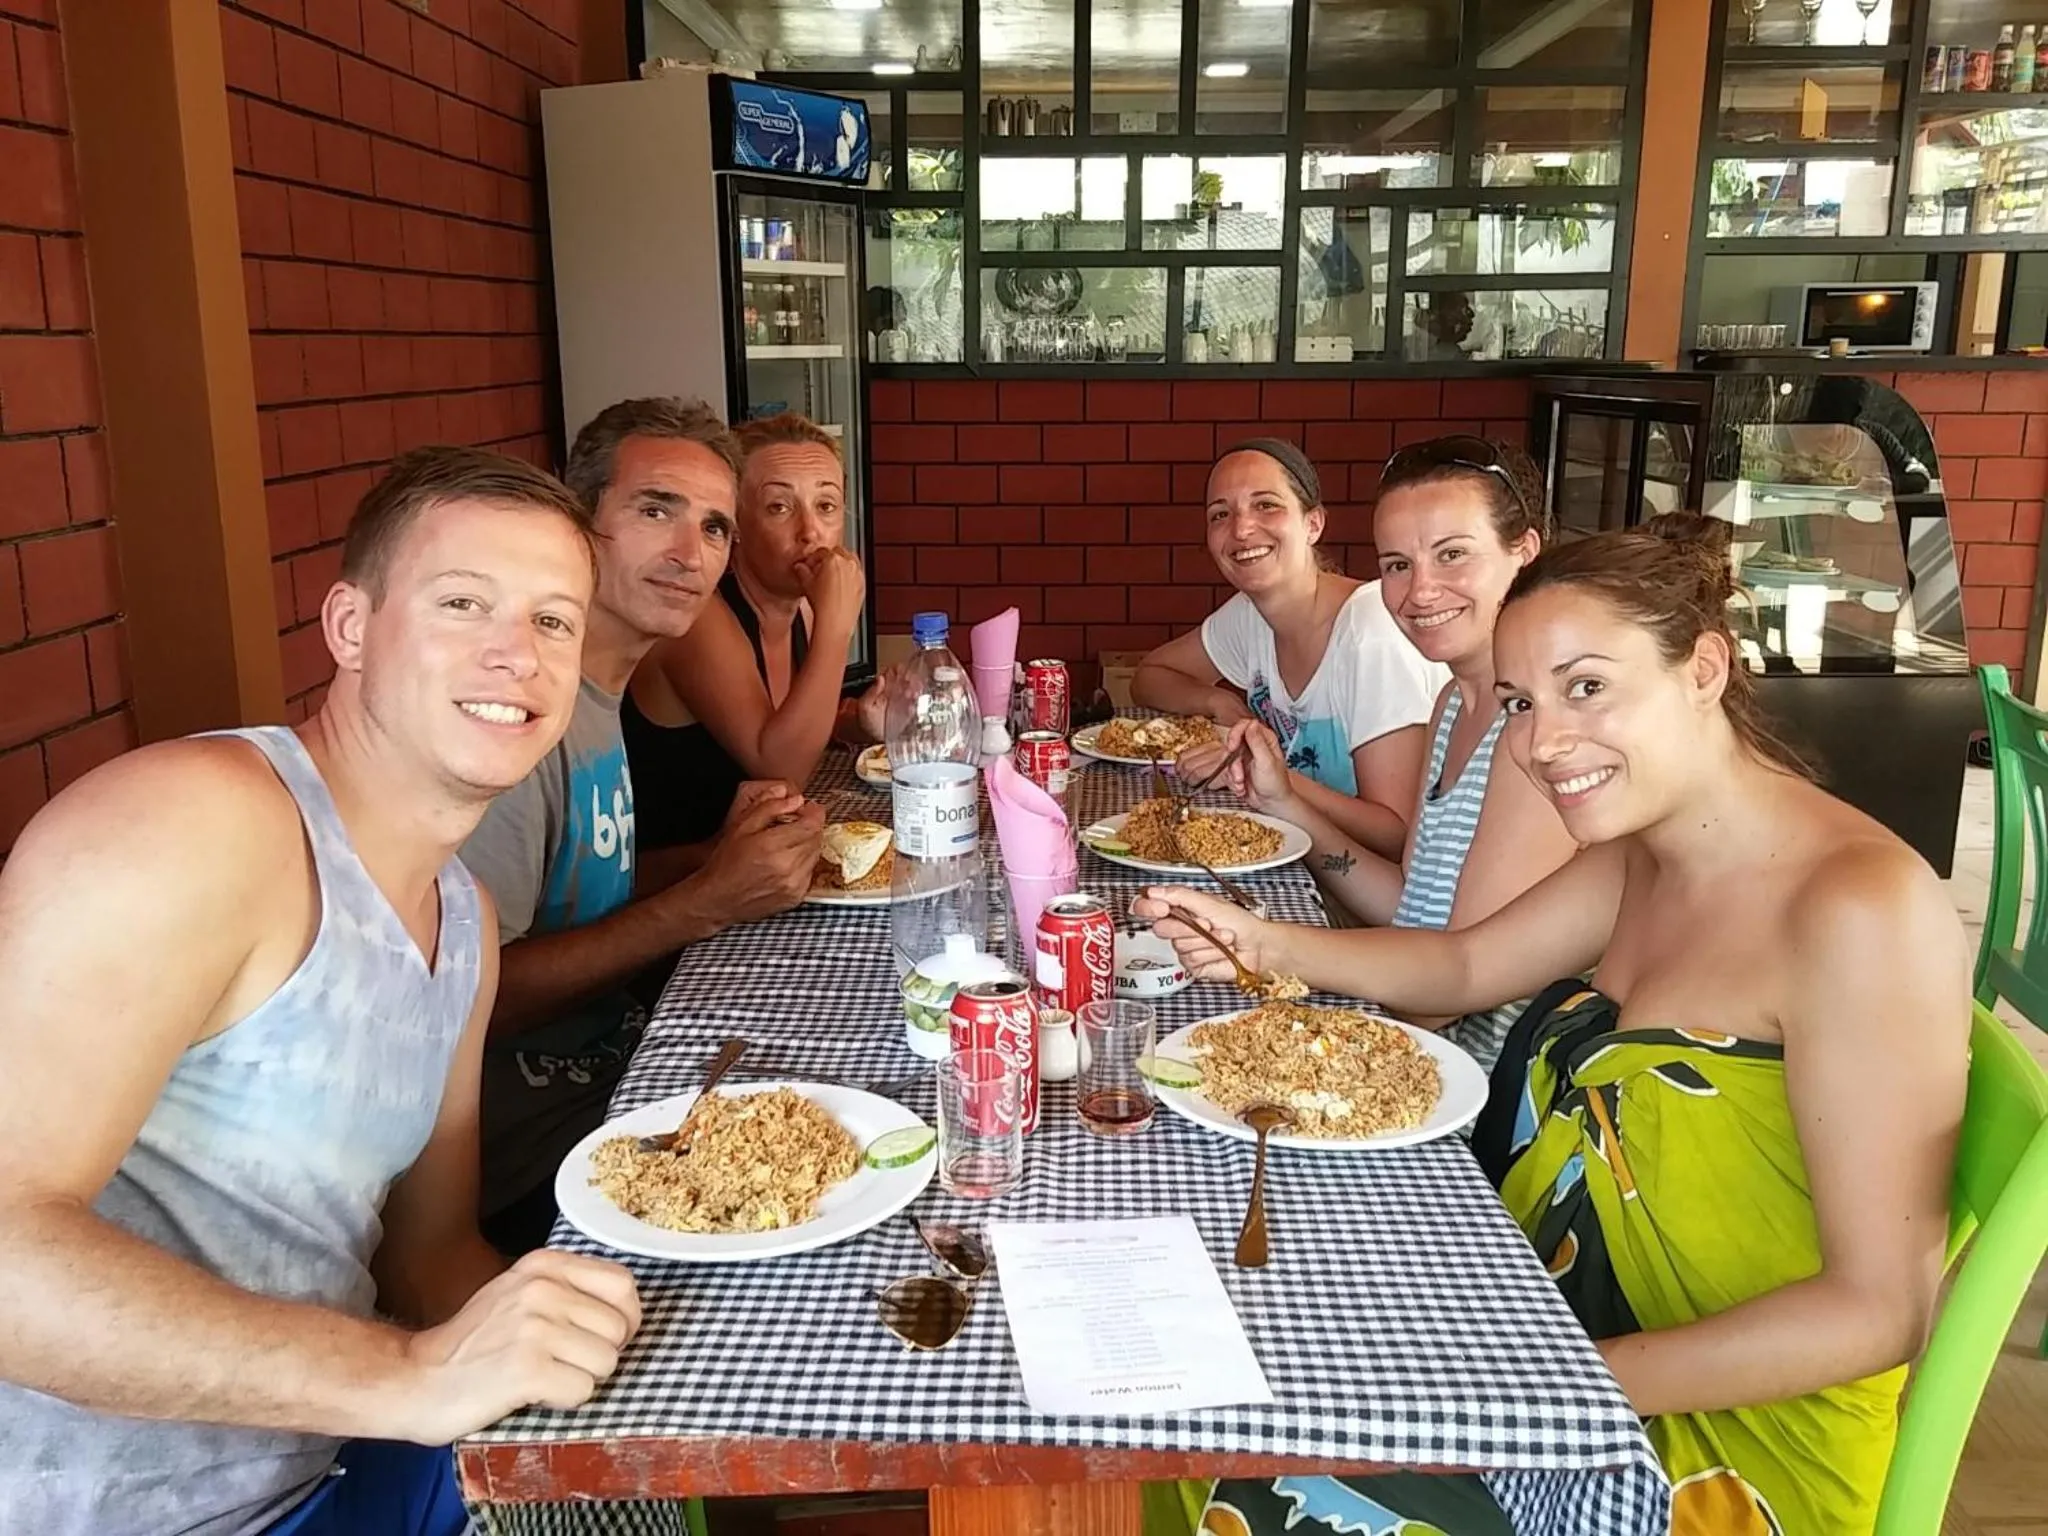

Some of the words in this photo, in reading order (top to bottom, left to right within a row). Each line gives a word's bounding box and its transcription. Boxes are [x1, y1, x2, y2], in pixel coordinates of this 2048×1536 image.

[741, 105, 761, 118] SUPER
[763, 117, 791, 130] GENERAL
[1081, 918, 1112, 1026] Coca-Cola
[1090, 1386, 1132, 1396] Water
